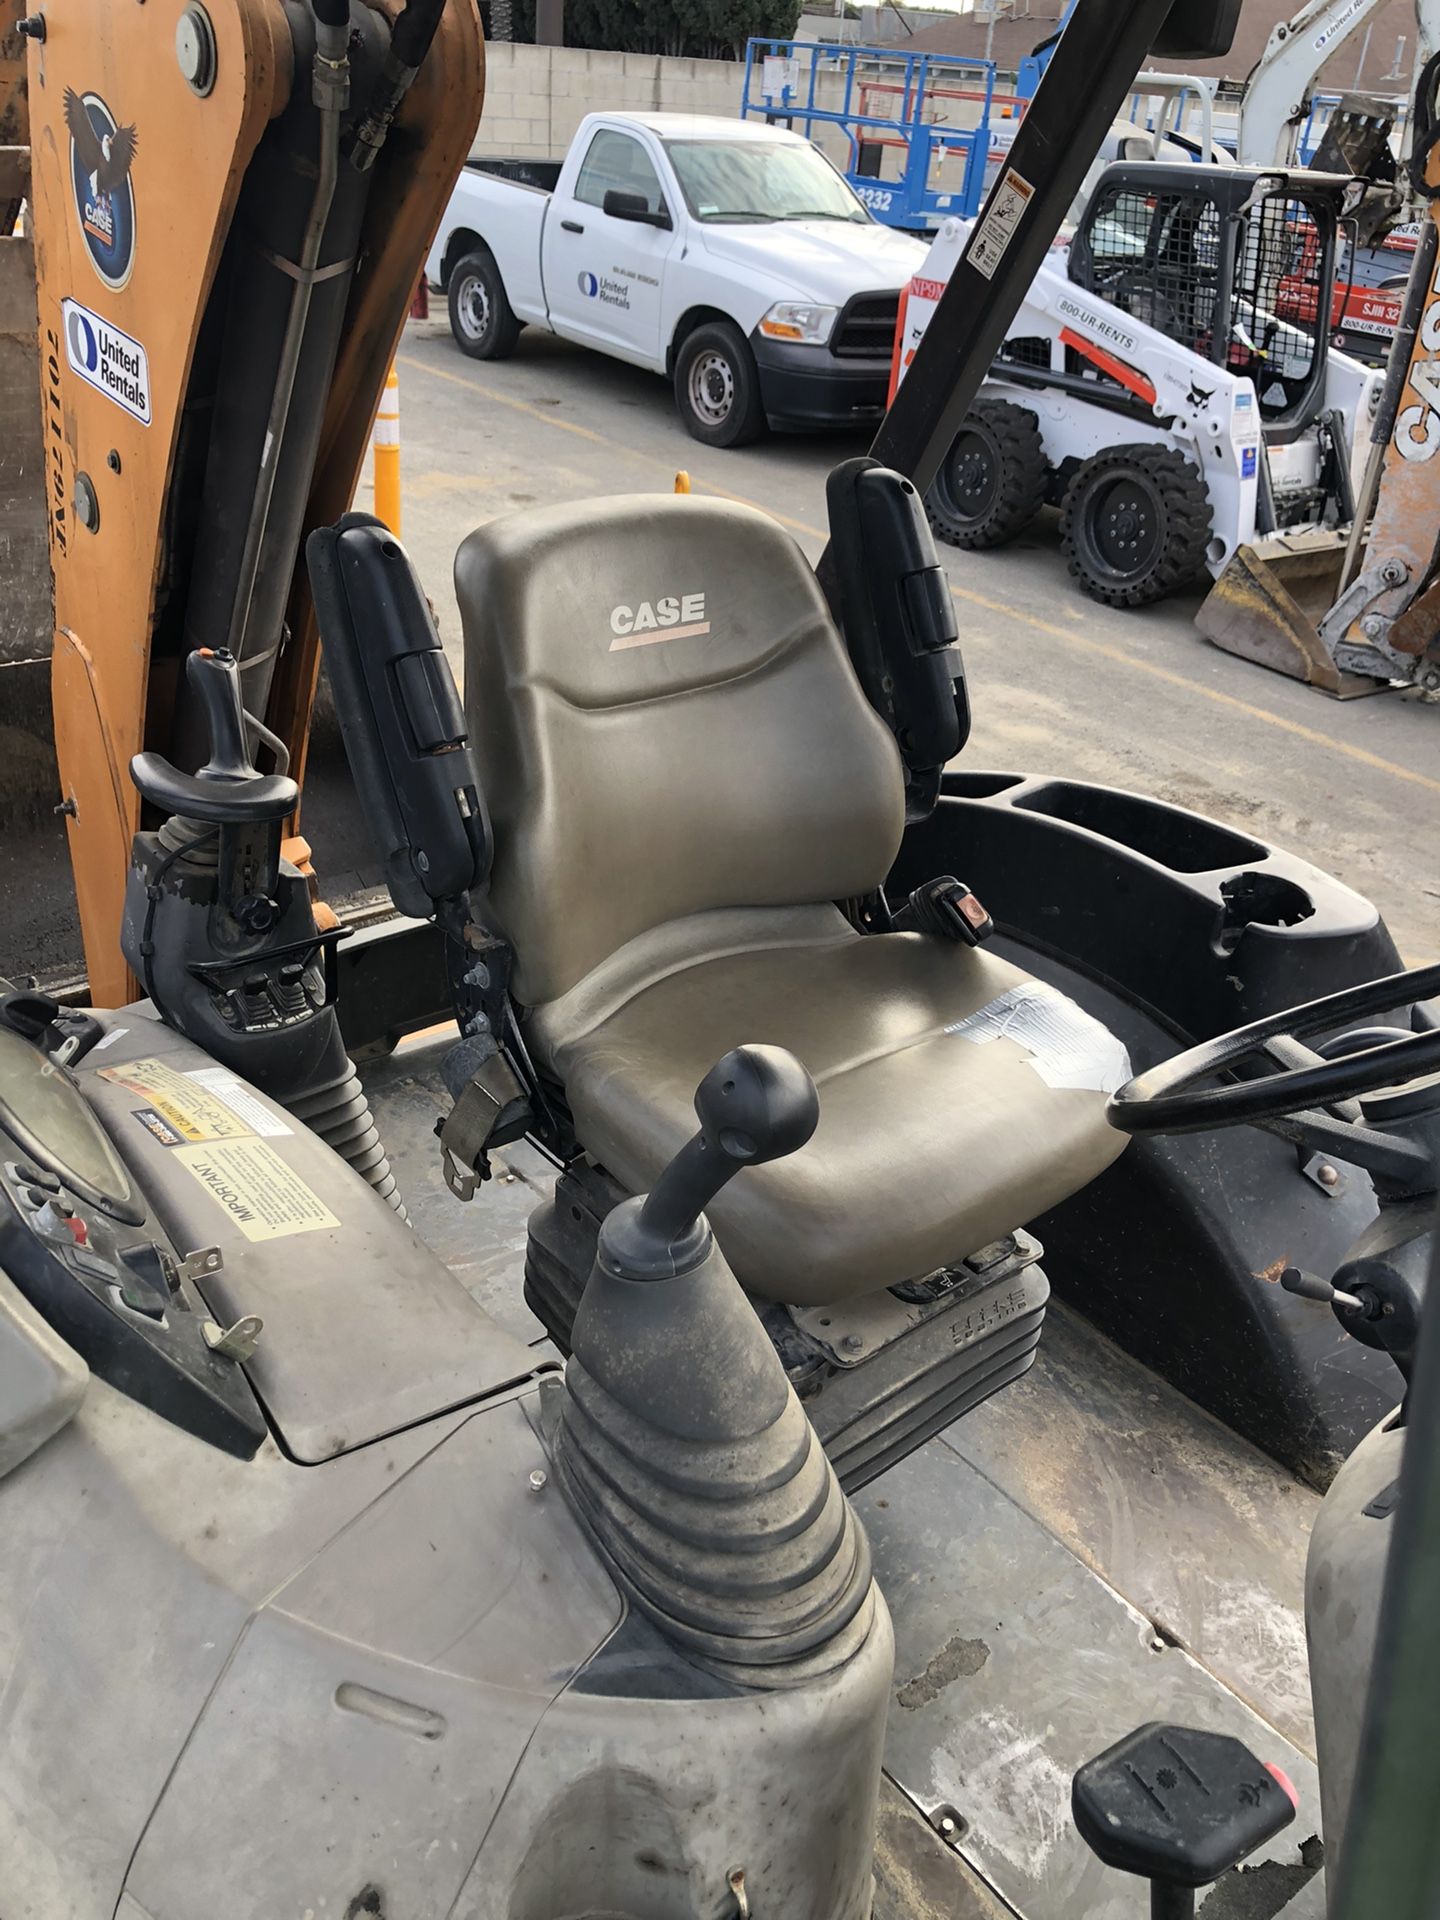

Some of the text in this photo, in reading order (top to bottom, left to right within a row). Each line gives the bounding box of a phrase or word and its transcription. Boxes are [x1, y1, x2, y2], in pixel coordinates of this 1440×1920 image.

[1326, 7, 1353, 38] United
[85, 202, 112, 235] CASE
[599, 290, 630, 310] Rentals
[600, 276, 628, 297] United
[1060, 300, 1134, 349] 800-UR-RENTS
[1343, 319, 1393, 336] 800-UR-REN
[99, 329, 139, 379] United
[101, 358, 146, 410] Rentals
[610, 593, 705, 635] CASE
[192, 1162, 256, 1223] IMPORTANT
